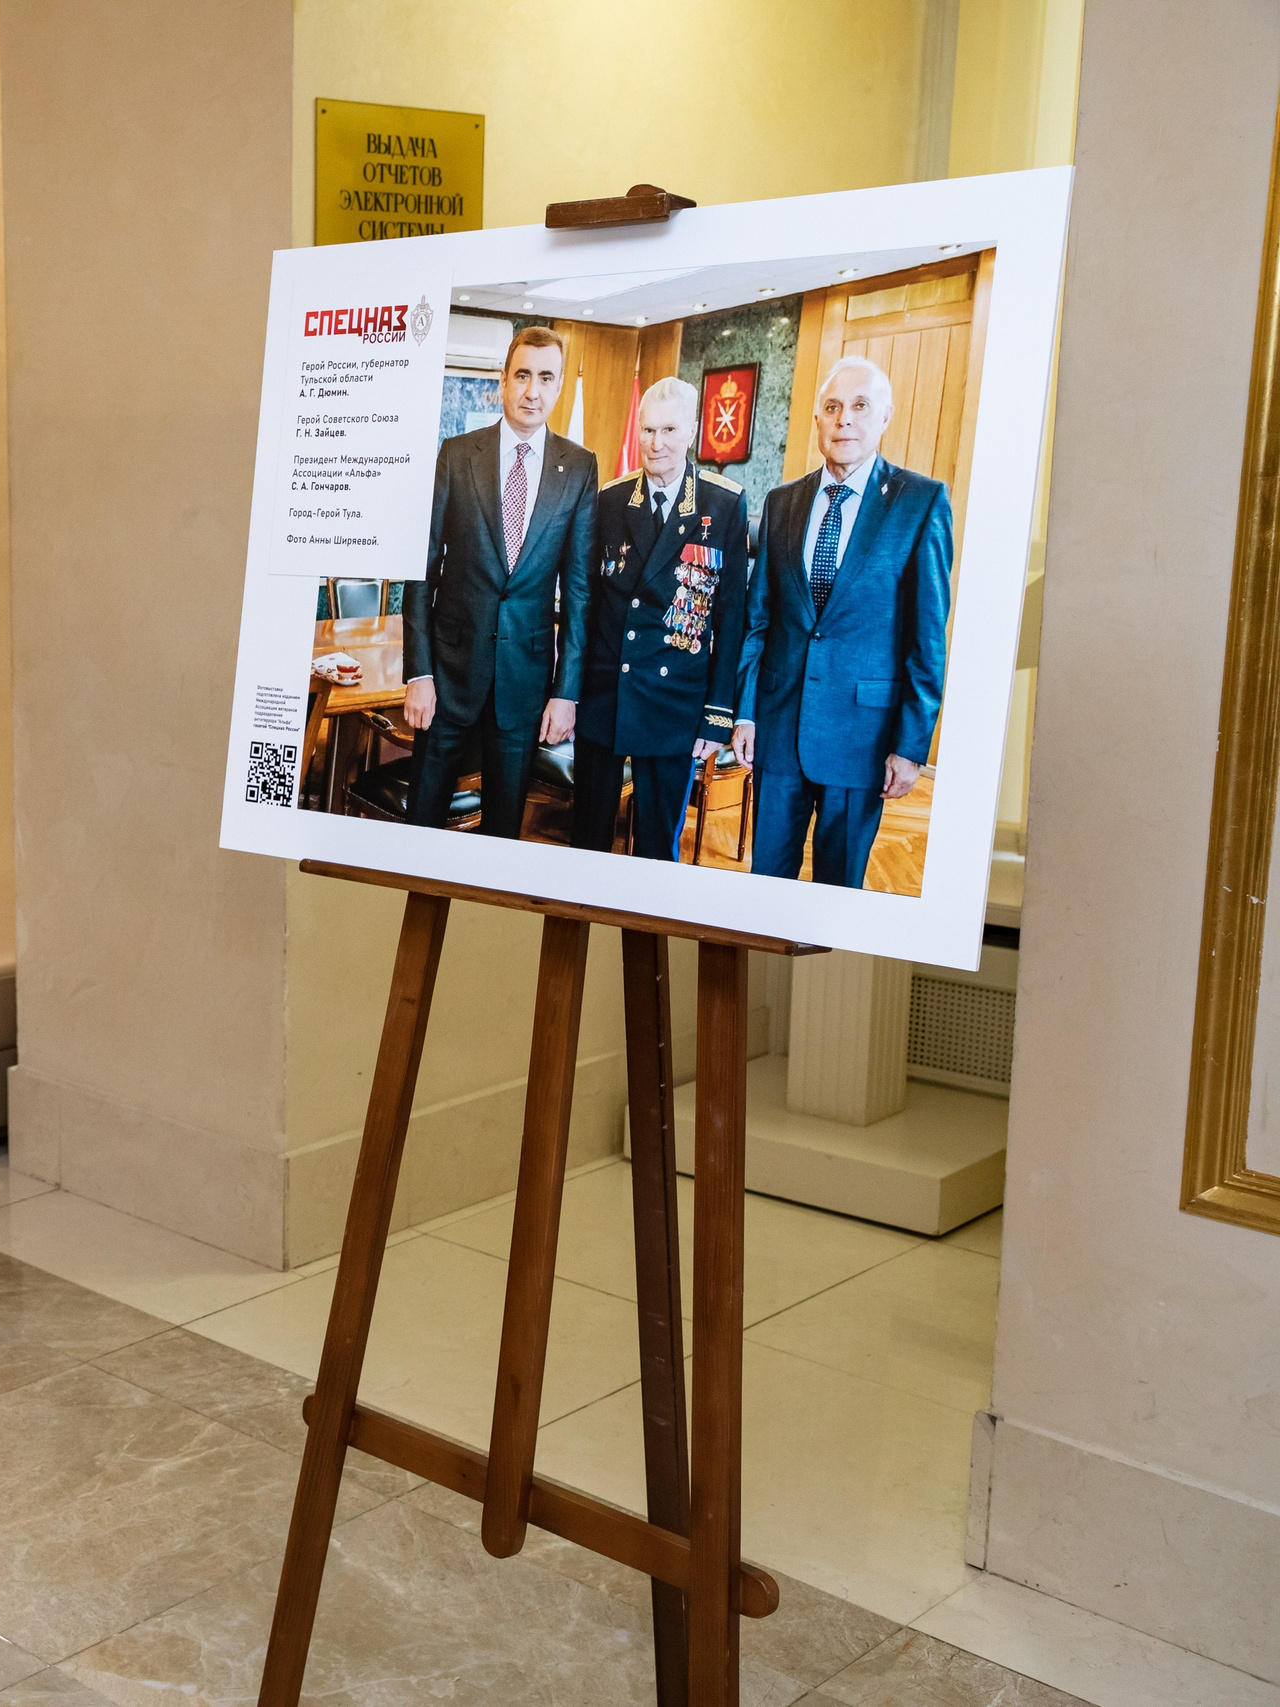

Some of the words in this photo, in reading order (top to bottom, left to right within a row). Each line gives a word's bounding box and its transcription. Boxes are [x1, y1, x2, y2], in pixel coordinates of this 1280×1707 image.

[366, 133, 438, 159] ВЫДАЧА
[363, 162, 442, 187] ОТЧЕТОВ
[339, 189, 464, 216] ЭЛЕКТРОННОЙ
[304, 305, 409, 337] СПЕЦНАЗ
[362, 331, 406, 344] РОССИИ
[301, 361, 325, 372] Герой
[327, 360, 359, 371] России,
[361, 358, 409, 370] губернатор
[300, 374, 337, 386] Тульской
[339, 373, 373, 383] области
[299, 389, 307, 398] А.
[309, 389, 316, 398] Г.
[318, 388, 349, 399] Дюмин.
[297, 415, 321, 426] Герой
[322, 414, 369, 424] Советского
[371, 413, 399, 423] Союза
[296, 428, 302, 438] Г.
[304, 429, 313, 438] Н.
[314, 428, 347, 439] Зайцев.
[293, 455, 337, 466] Президент
[340, 454, 410, 465] Международной
[292, 468, 343, 478] Ассоциации
[344, 469, 381, 478] «Альфа»
[291, 482, 299, 491] С.
[300, 482, 309, 491] А.
[310, 482, 351, 492] Гончаров.
[289, 508, 340, 519] Город-Герой
[342, 509, 363, 520] Тула.
[286, 534, 307, 544] Фото
[309, 534, 331, 544] Анны
[334, 535, 379, 547] Ширяевой.
